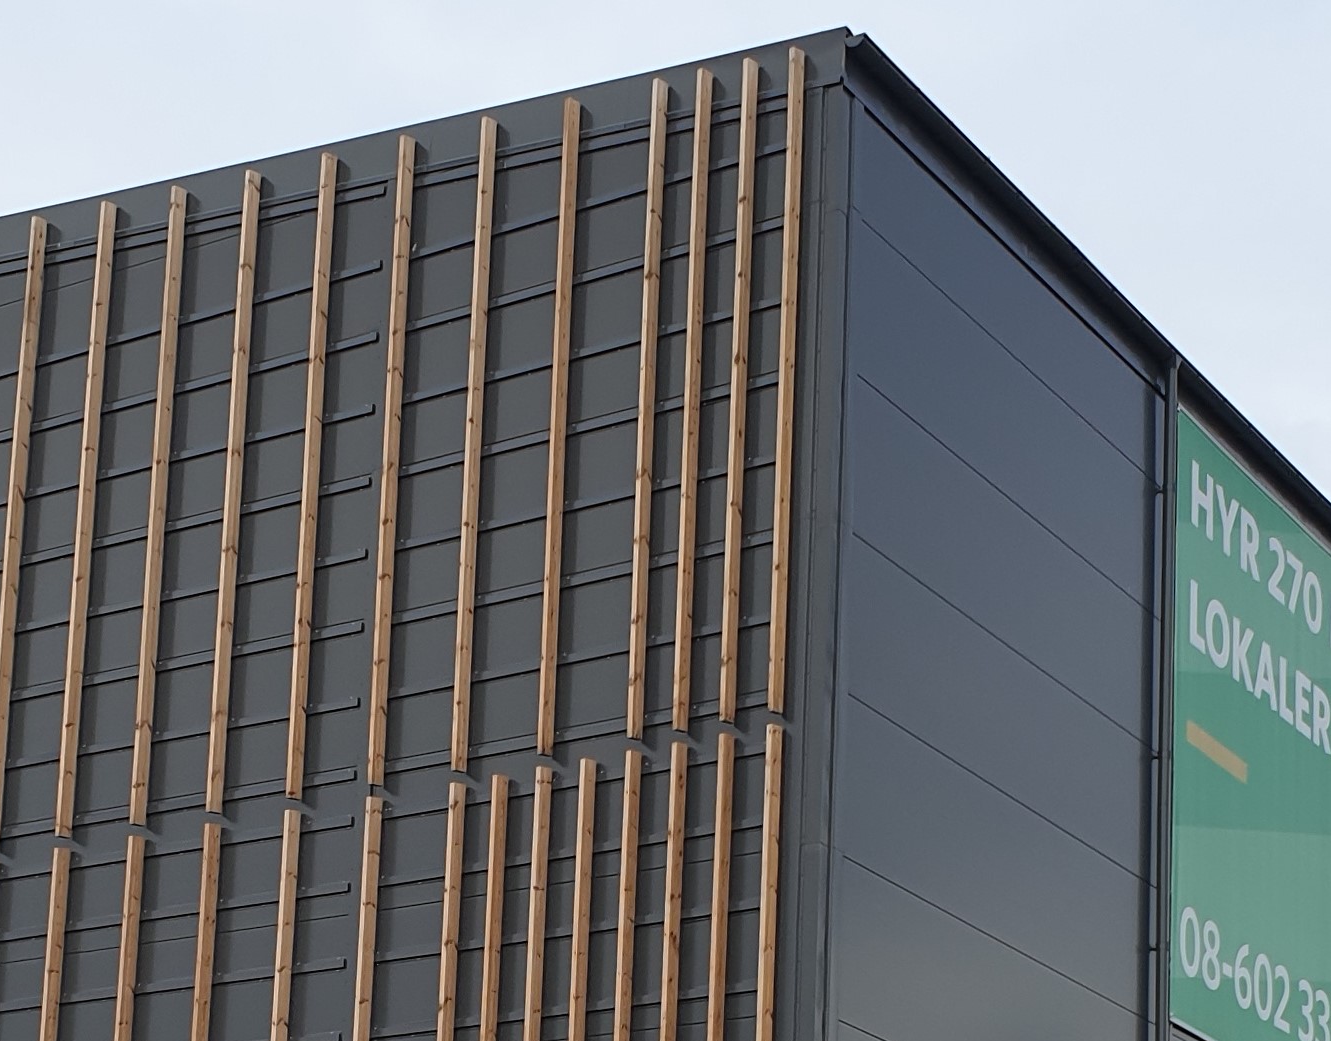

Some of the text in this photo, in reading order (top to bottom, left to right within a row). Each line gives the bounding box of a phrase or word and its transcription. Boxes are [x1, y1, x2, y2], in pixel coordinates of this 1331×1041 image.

[1191, 459, 1260, 582] HYR
[1268, 537, 1323, 634] 270
[1189, 579, 1331, 755] LOKALER
[1179, 906, 1290, 1034] 08-602
